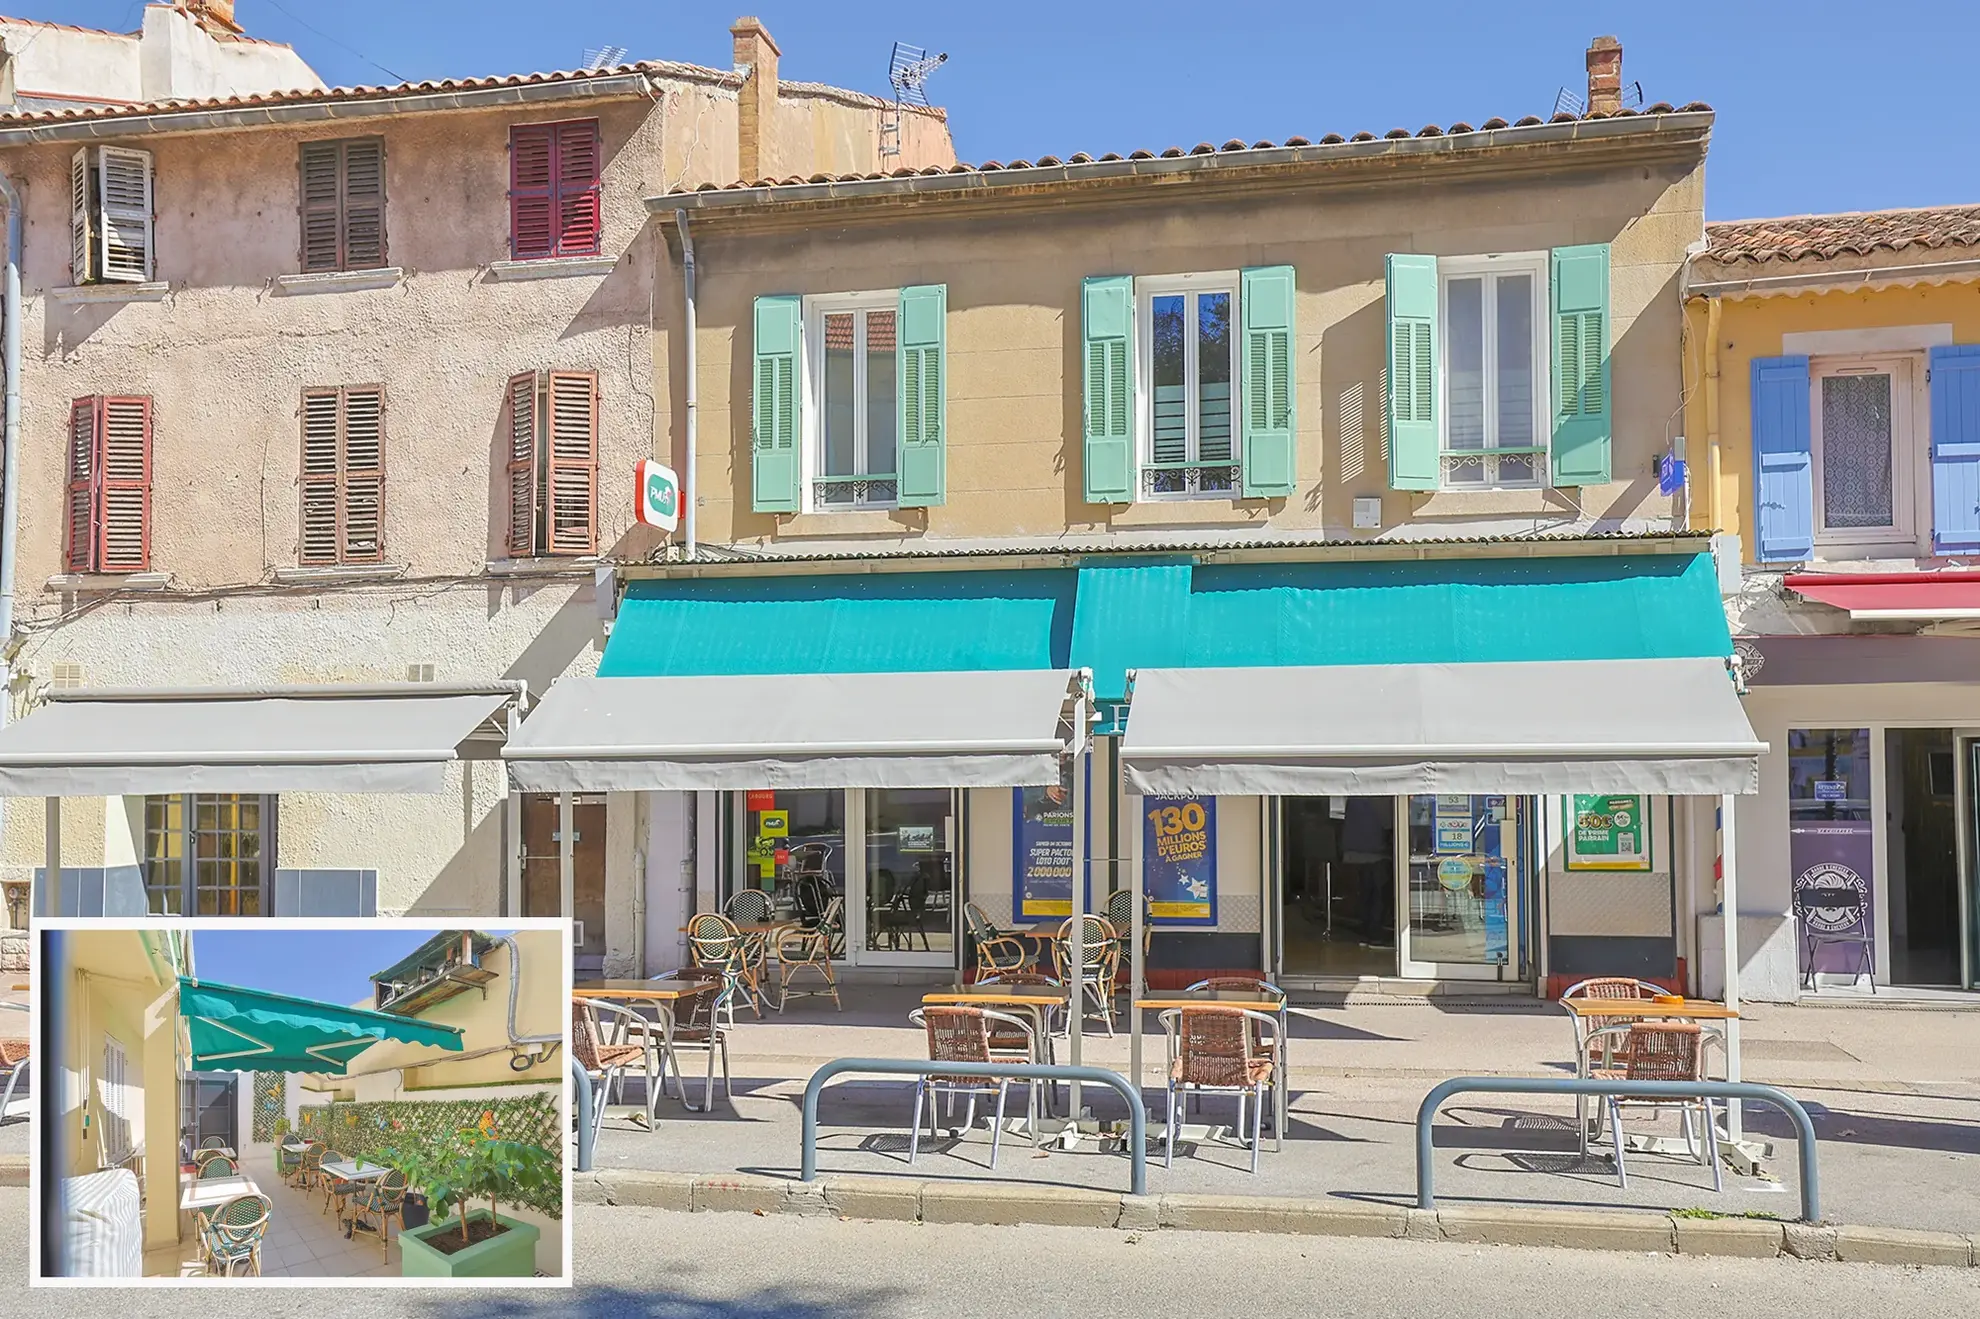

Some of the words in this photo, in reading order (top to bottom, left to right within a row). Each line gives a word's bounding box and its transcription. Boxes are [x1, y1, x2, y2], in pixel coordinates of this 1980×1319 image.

[1147, 802, 1206, 837] 130
[1157, 831, 1207, 847] MILLIONS
[1452, 832, 1463, 840] 18
[1030, 848, 1050, 857] SUPER
[1051, 848, 1073, 857] PACTO
[1158, 840, 1207, 857] D'EUROS
[1036, 857, 1053, 865] LOTO
[1053, 857, 1071, 865] FOOT
[1171, 851, 1203, 862] GAGNER
